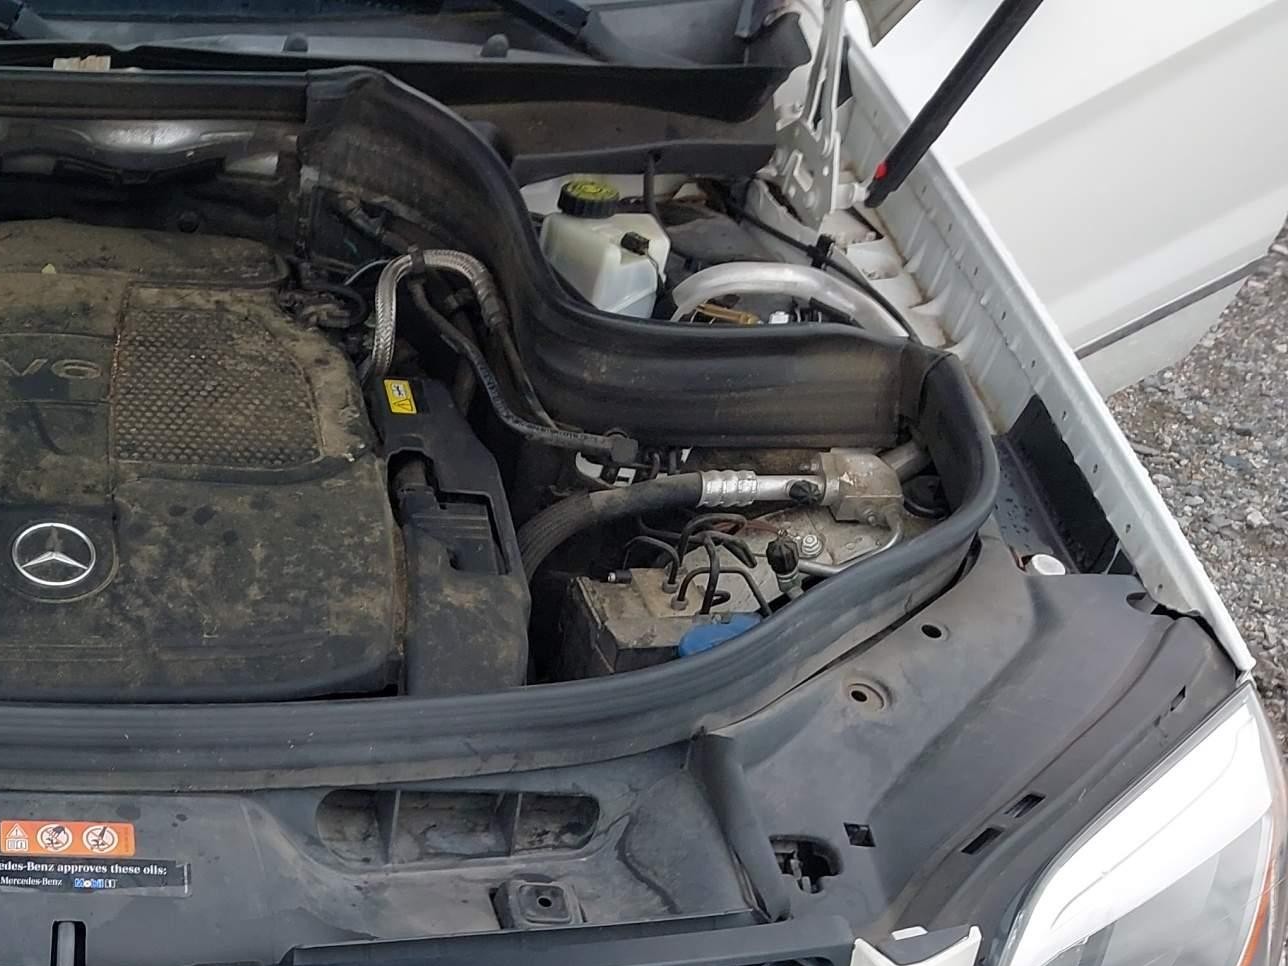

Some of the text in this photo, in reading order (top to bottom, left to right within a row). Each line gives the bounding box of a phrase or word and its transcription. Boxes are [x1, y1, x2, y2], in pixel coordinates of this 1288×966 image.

[57, 864, 107, 874] approves
[110, 864, 141, 874] these
[143, 864, 167, 875] oils:
[0, 876, 63, 886] Mercedes-Benz
[74, 878, 104, 888] Mobil
